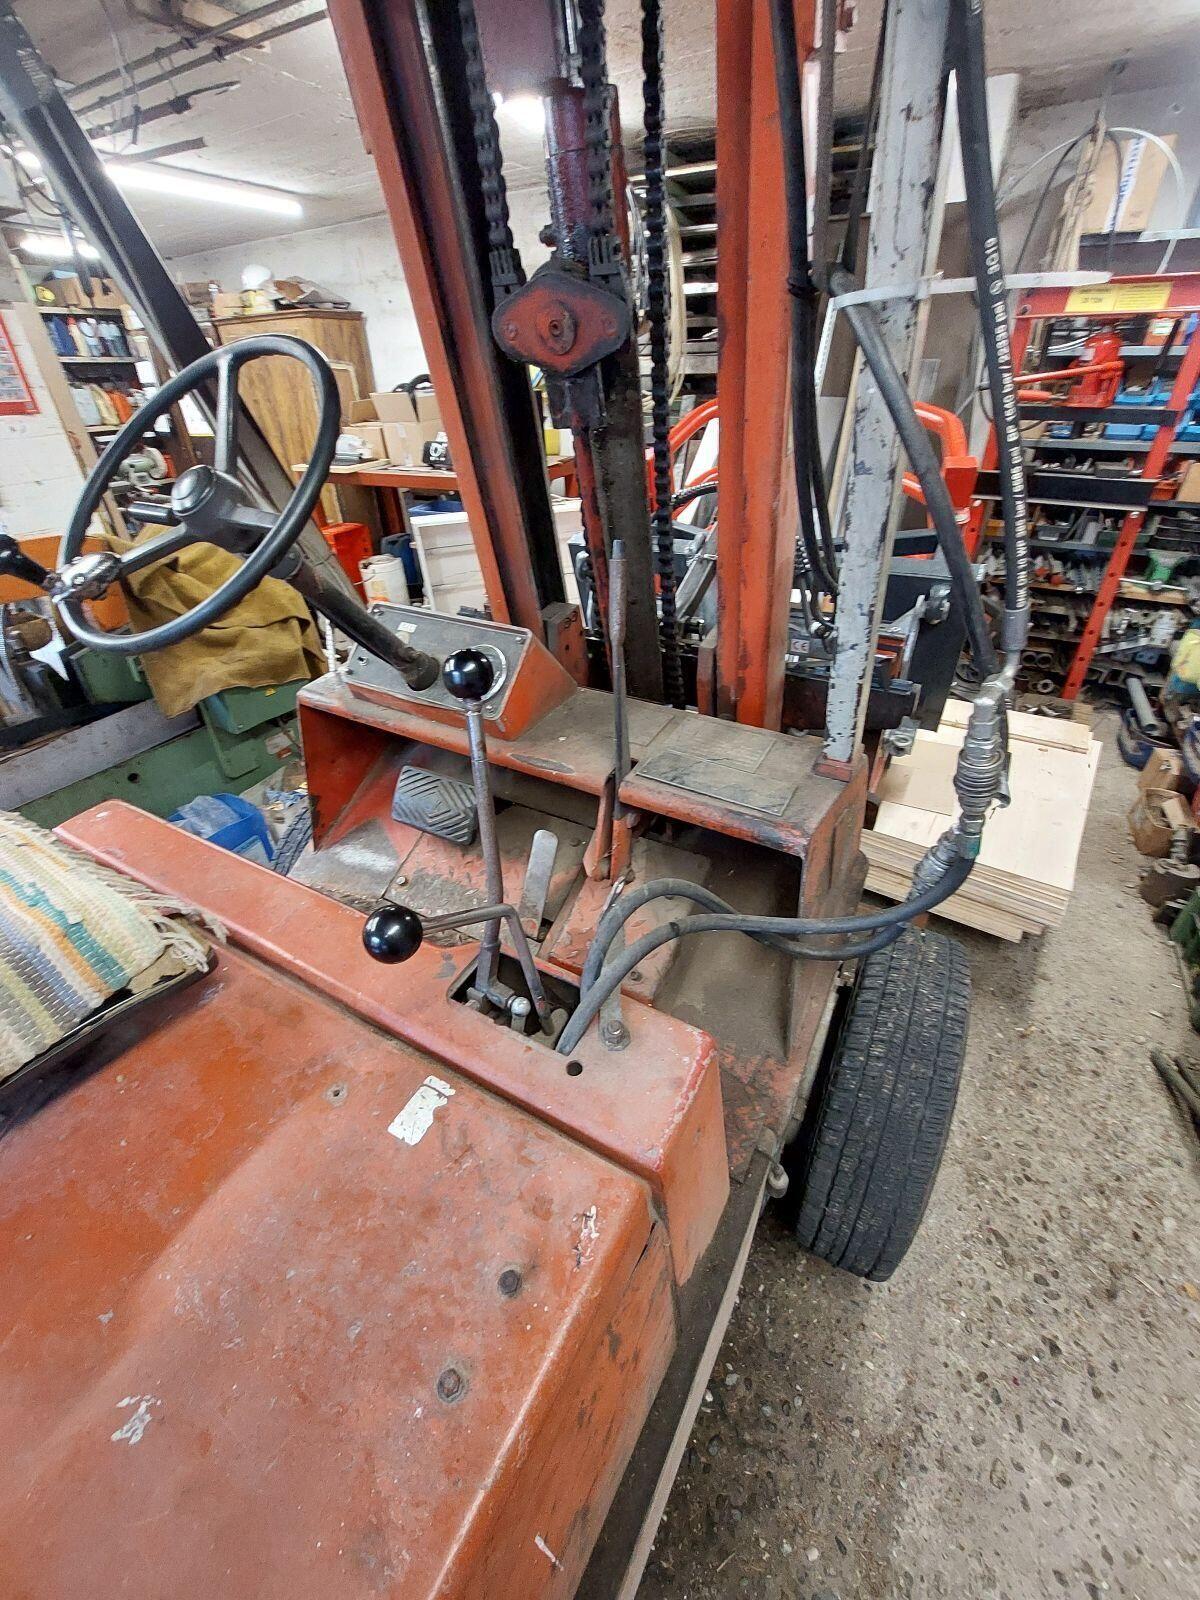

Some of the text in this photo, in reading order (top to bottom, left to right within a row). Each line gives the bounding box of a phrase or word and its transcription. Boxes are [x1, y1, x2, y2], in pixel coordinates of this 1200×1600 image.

[991, 300, 1008, 322] psi
[1001, 372, 1015, 393] bar
[1008, 446, 1023, 464] psi
[1013, 500, 1026, 518] bar
[1014, 540, 1028, 557] WP
